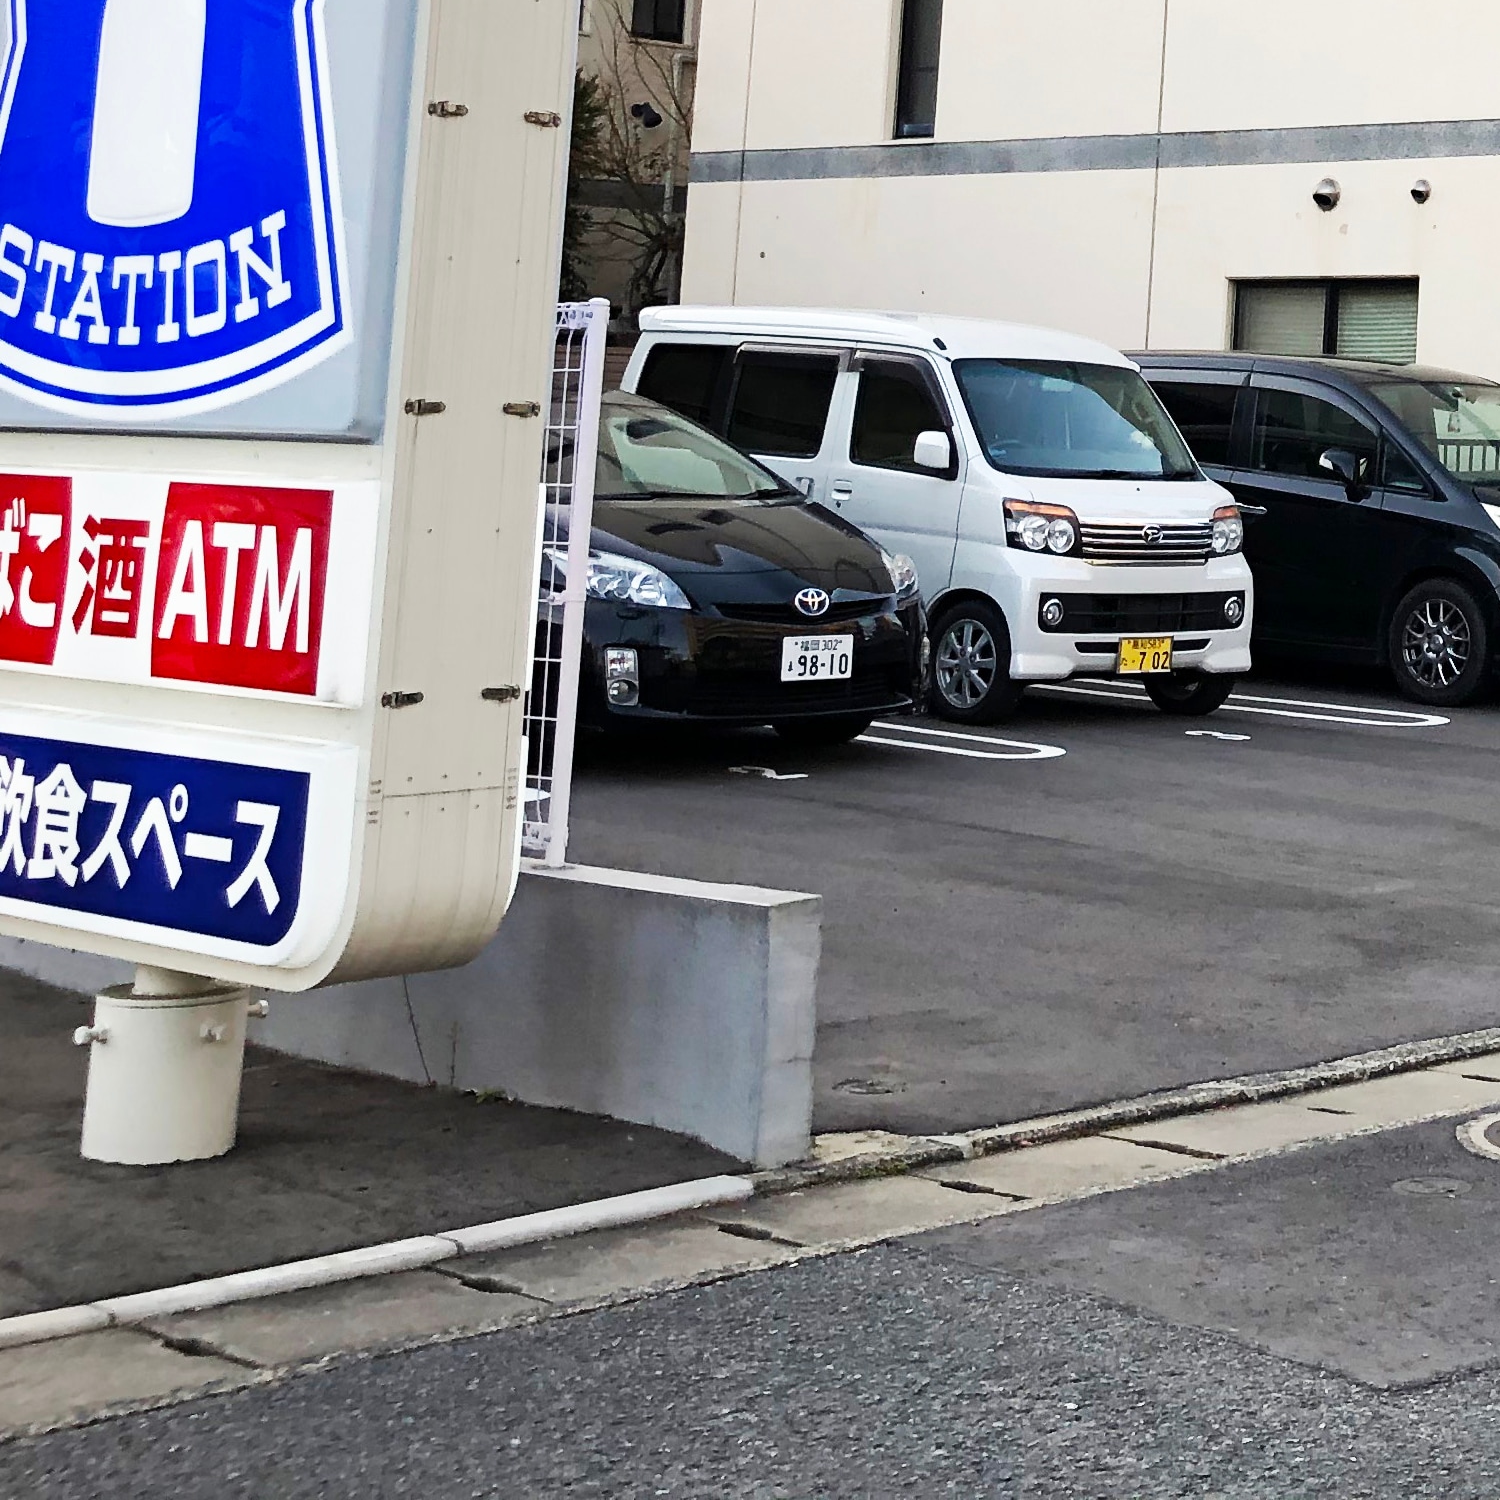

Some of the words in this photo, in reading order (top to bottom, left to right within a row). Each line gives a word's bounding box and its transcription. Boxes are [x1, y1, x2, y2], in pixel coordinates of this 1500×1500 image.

[0, 209, 292, 346] STATION
[72, 514, 151, 639] 酒
[158, 519, 312, 654] ATM
[799, 640, 820, 652] 福岡
[821, 638, 840, 652] 302
[797, 652, 849, 677] 98-10
[0, 754, 282, 917] 飲食スペース
